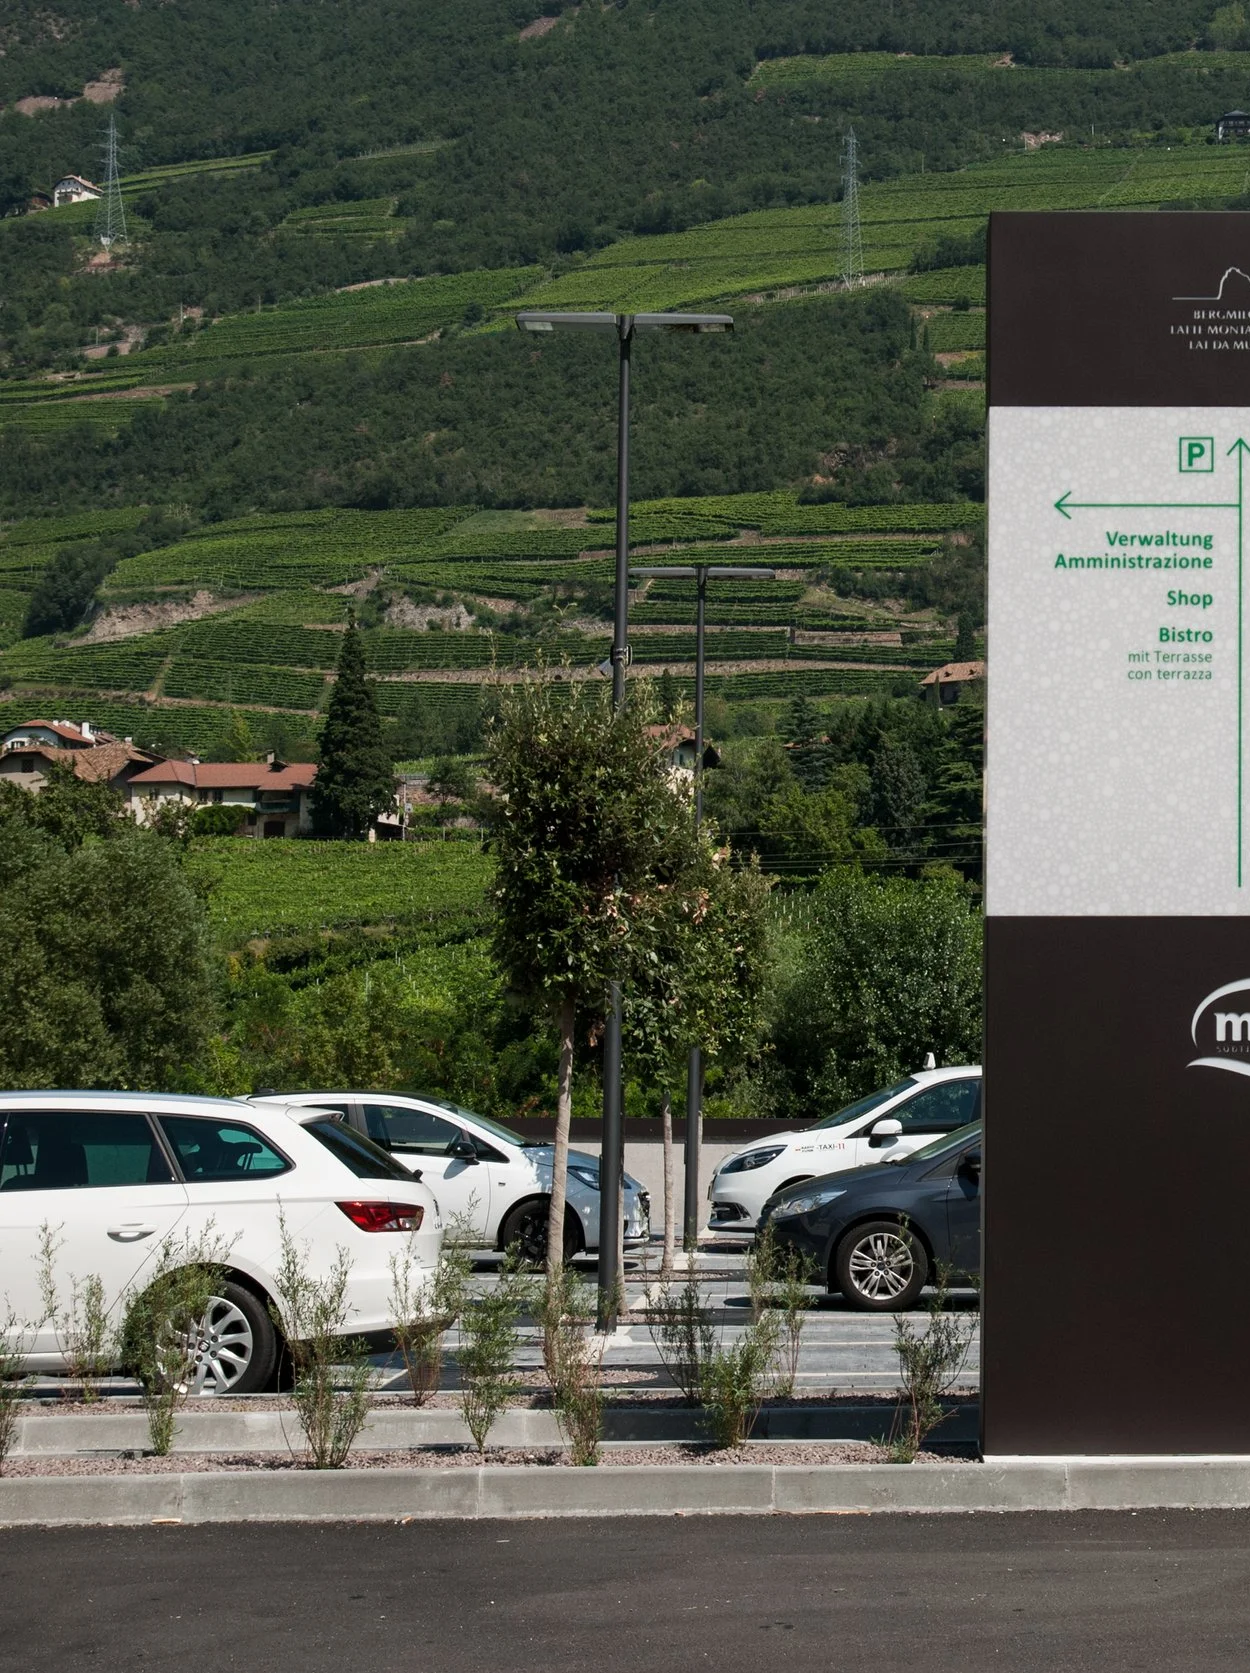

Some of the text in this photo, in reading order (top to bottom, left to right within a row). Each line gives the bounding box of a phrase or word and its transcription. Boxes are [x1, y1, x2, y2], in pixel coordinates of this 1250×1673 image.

[1212, 340, 1230, 350] DA
[1187, 442, 1205, 466] P
[1106, 531, 1213, 550] Verwaltung
[1054, 553, 1213, 571] Amministrazione
[1166, 590, 1213, 608] Shop
[1159, 627, 1213, 643] Bistro
[1128, 650, 1213, 664] mit Terrasse
[1127, 668, 1212, 681] con terrazza
